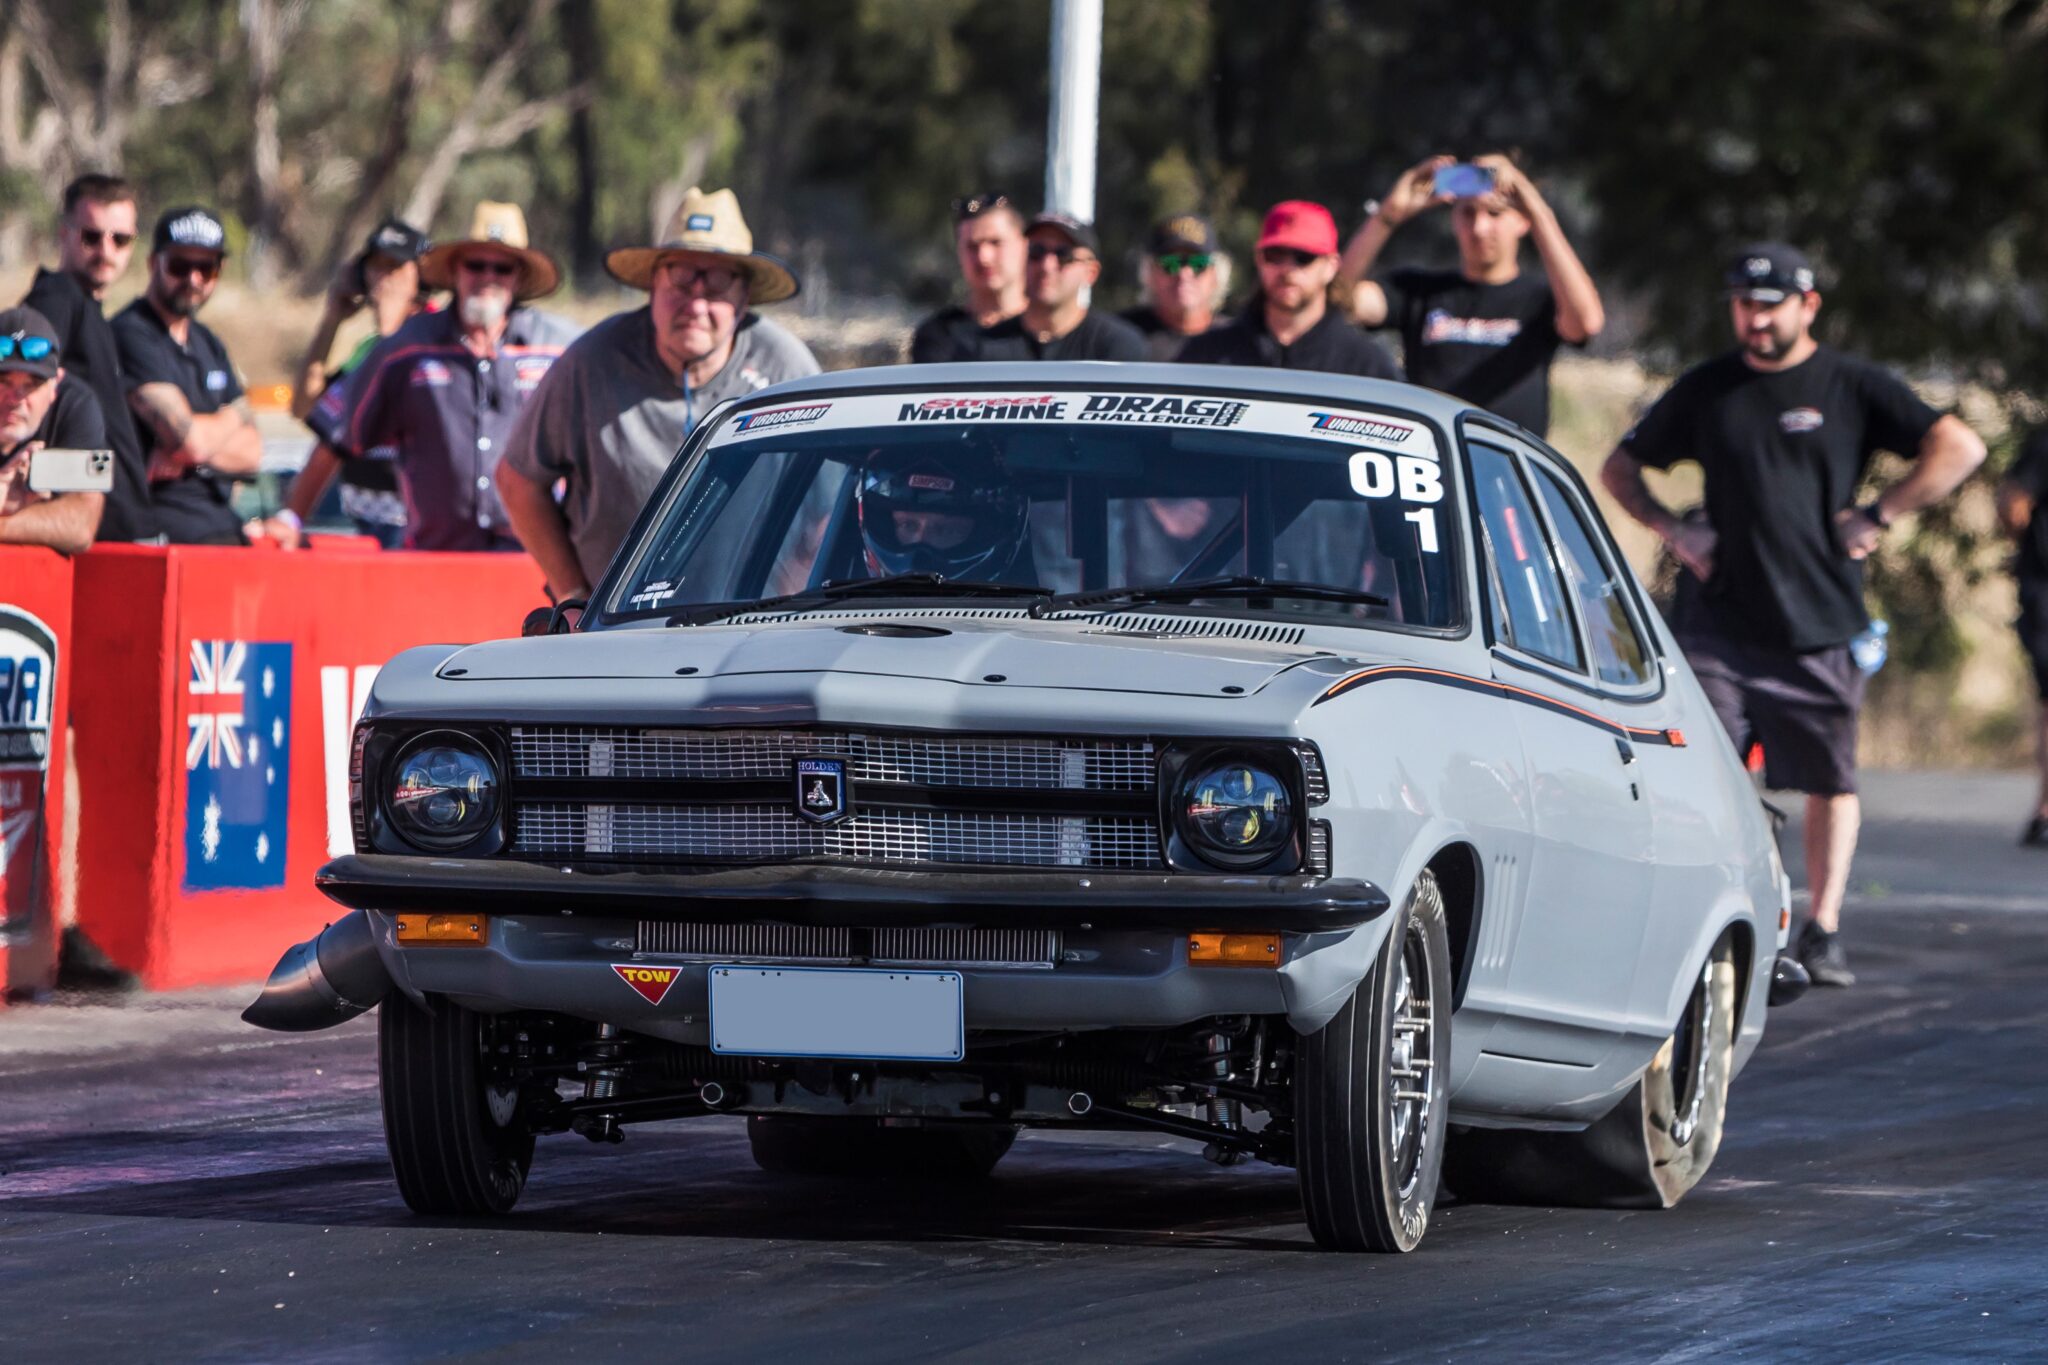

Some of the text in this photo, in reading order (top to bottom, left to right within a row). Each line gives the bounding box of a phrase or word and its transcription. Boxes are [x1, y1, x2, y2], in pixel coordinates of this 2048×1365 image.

[898, 402, 1068, 421] MACHINE
[1083, 395, 1223, 416] DRAG
[732, 404, 831, 432] TURBOSMART
[1077, 412, 1211, 426] CHALLENGE
[1308, 413, 1411, 442] TURBOSMART
[1404, 507, 1439, 554] 1
[798, 761, 842, 771] HOLDEN
[622, 969, 671, 983] TOW
